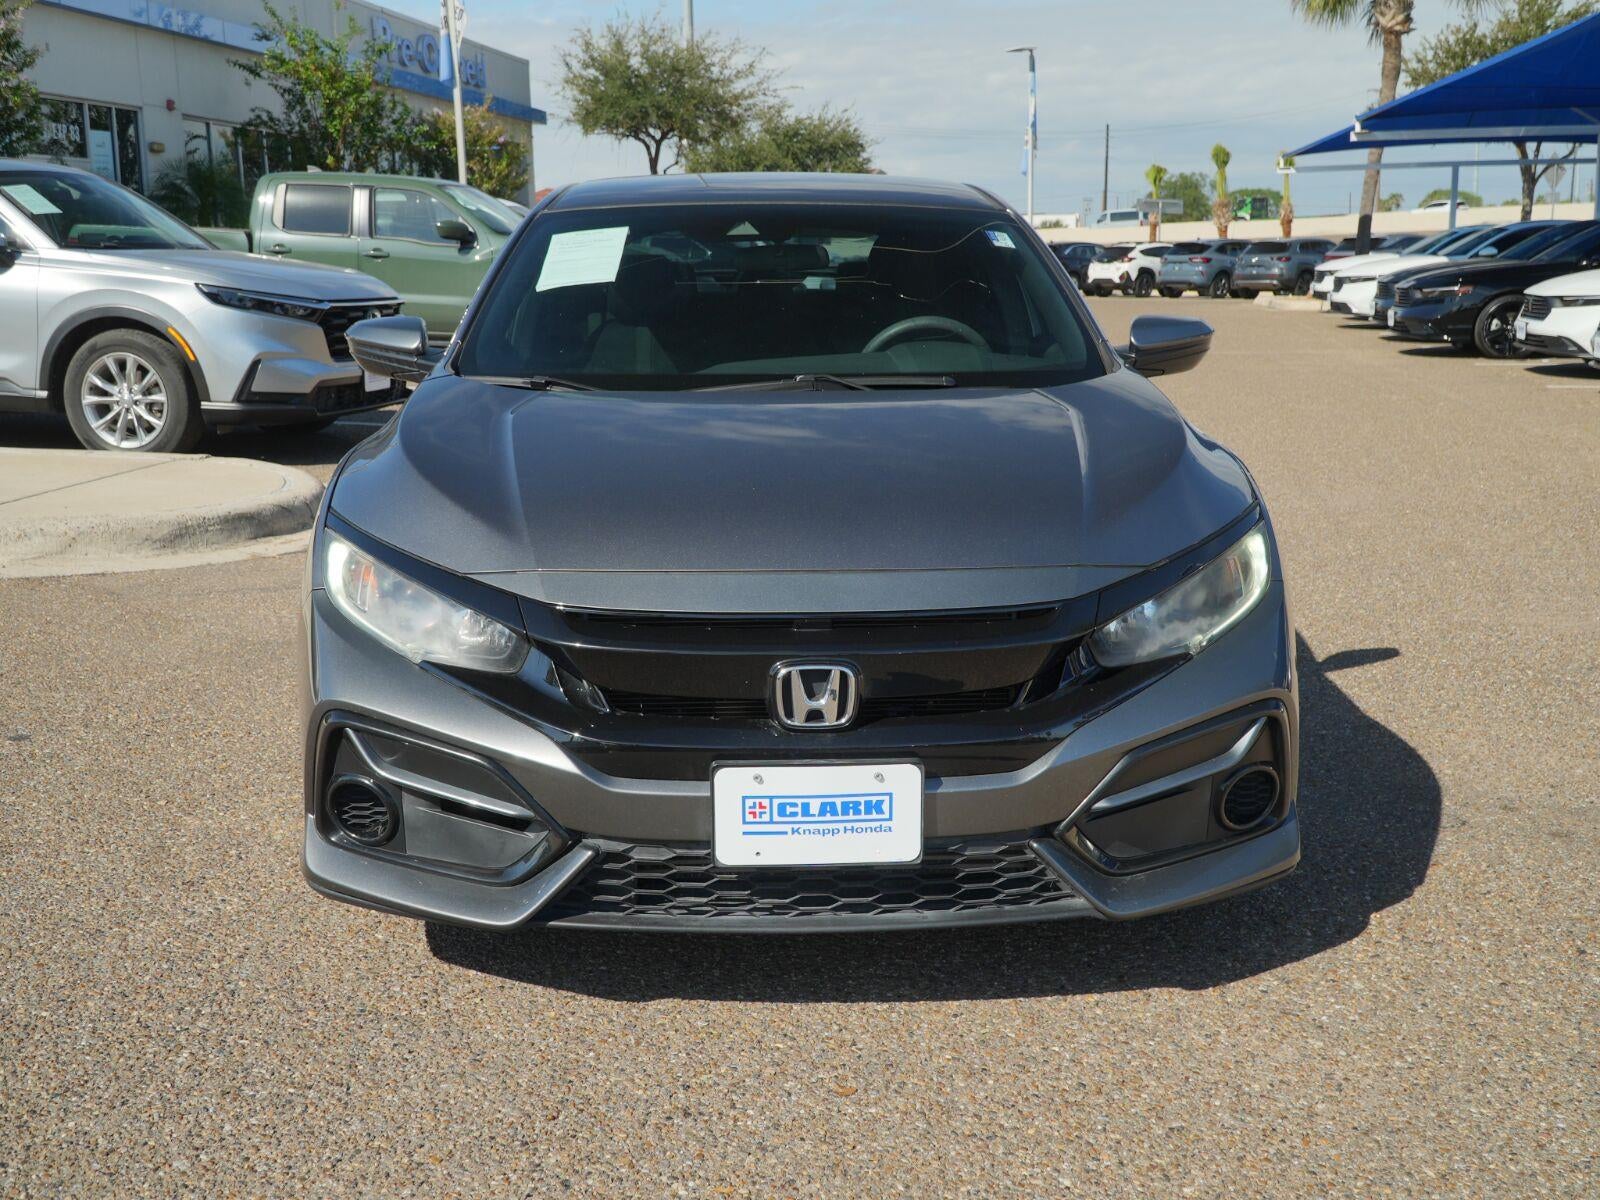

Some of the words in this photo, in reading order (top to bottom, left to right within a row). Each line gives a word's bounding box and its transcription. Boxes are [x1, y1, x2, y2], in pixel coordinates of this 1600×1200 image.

[776, 799, 885, 818] CLARK
[790, 826, 840, 837] Knapp
[843, 824, 893, 834] Honda
